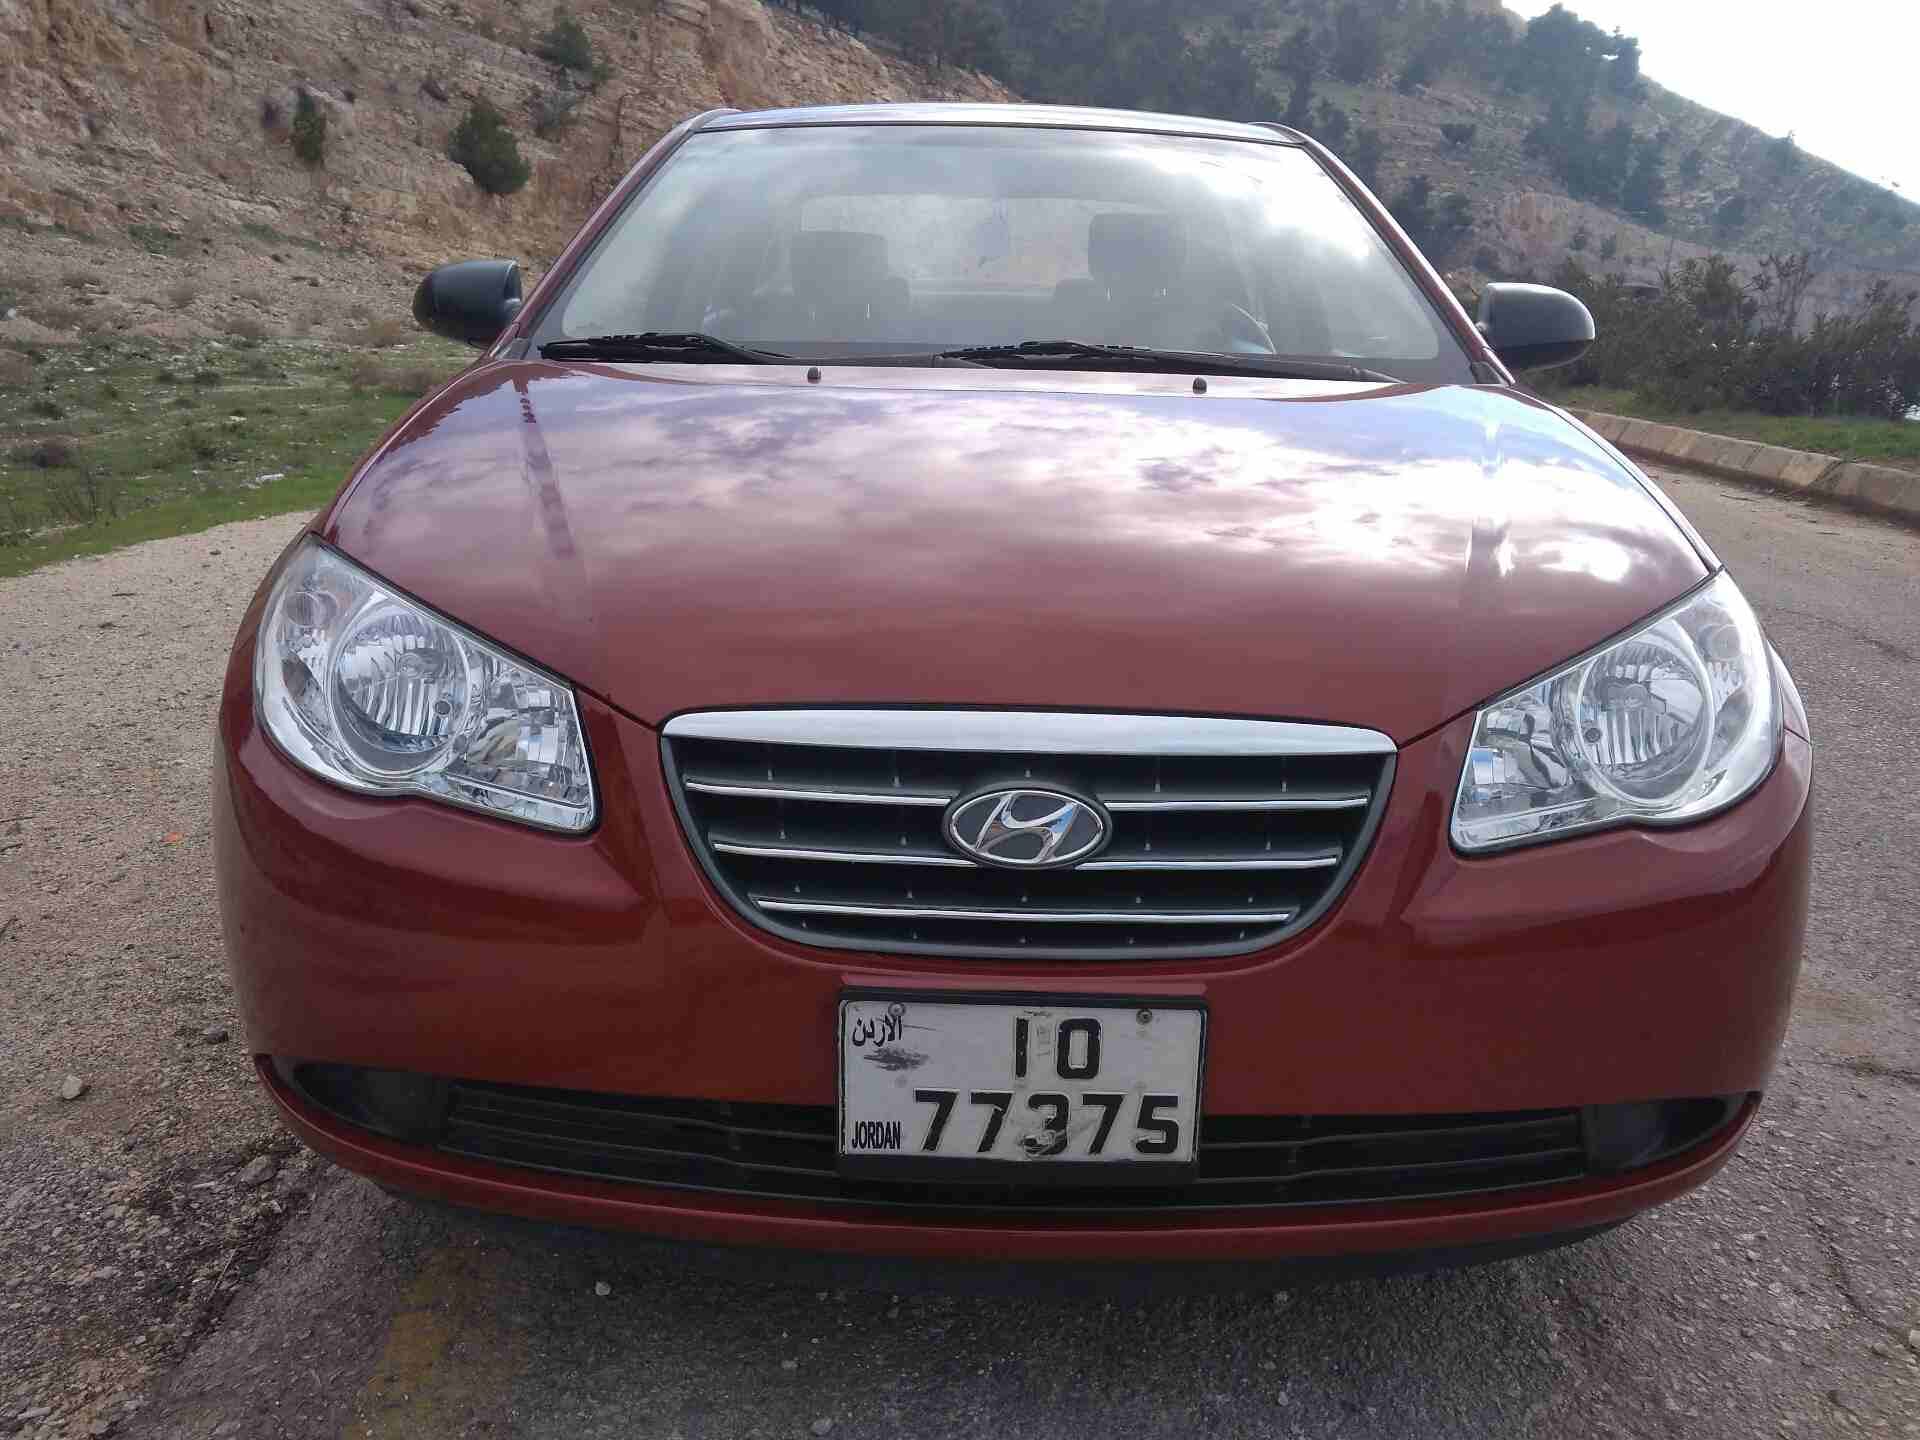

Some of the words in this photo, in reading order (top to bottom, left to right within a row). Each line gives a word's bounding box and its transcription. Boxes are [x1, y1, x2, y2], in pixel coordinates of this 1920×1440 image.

[1014, 1017, 1102, 1080] 10
[851, 1120, 901, 1150] JORDAN
[914, 1089, 1180, 1156] 77375
